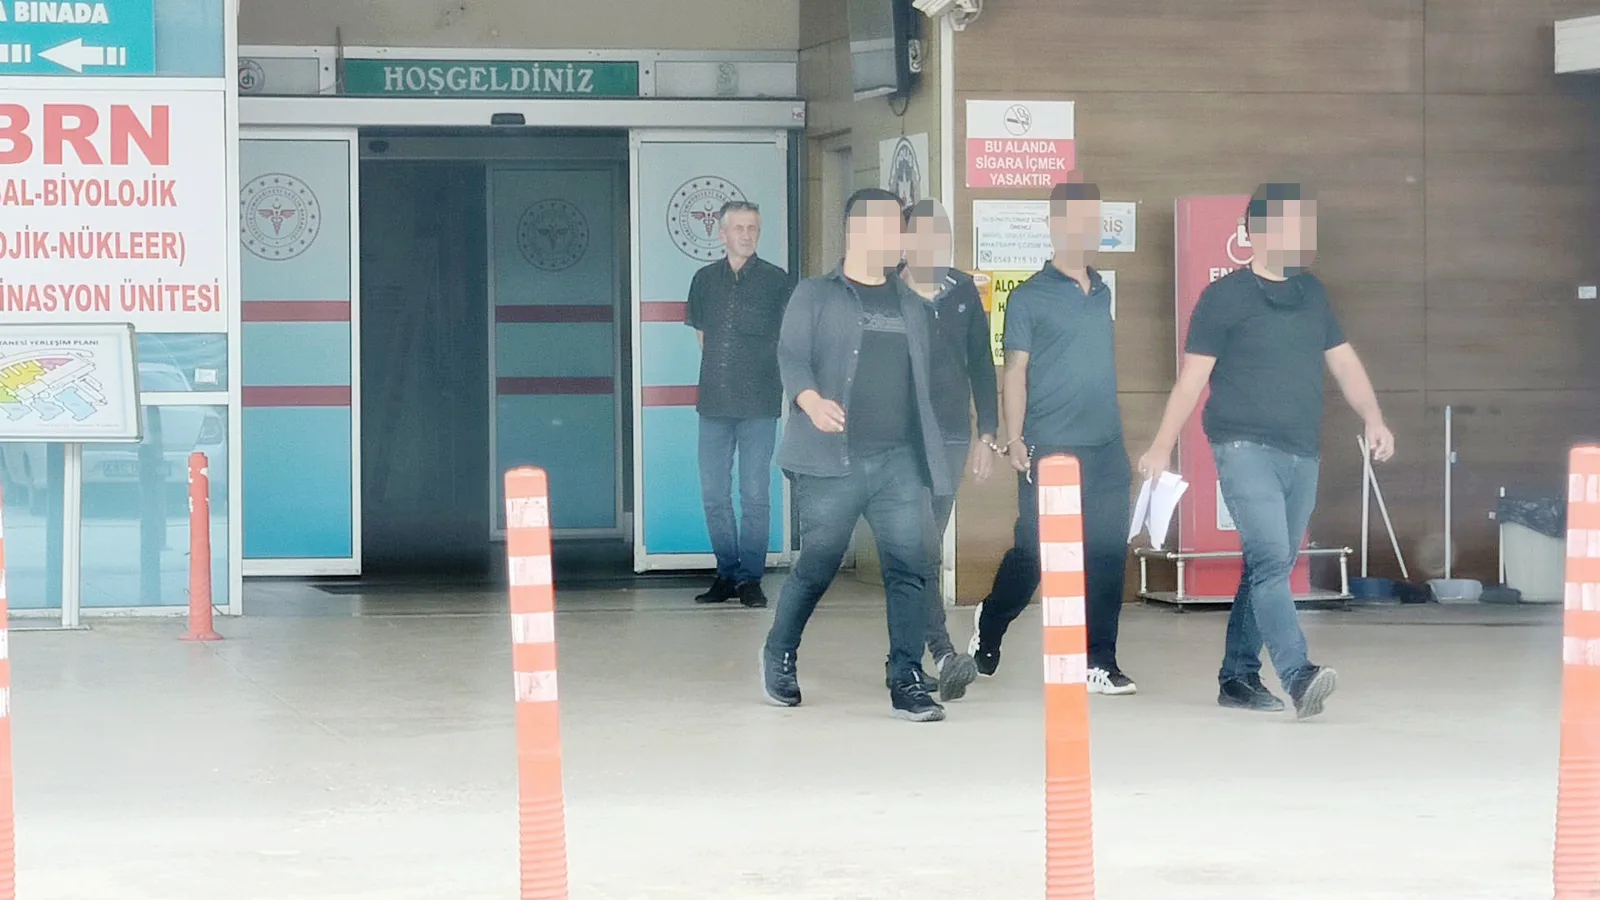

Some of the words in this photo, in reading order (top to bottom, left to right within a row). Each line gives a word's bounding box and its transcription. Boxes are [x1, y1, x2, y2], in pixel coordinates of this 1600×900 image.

[384, 63, 594, 95] HOŞGELDİNİZ
[985, 141, 1002, 153] BU
[1005, 141, 1056, 153] ALANDA
[976, 155, 1023, 169] SİGARA
[1026, 156, 1065, 172] İÇMEK
[0, 173, 177, 206] AL-BİYOLOJİK
[990, 173, 1051, 185] YASAKTIR
[120, 278, 220, 312] ÜNİTESİ
